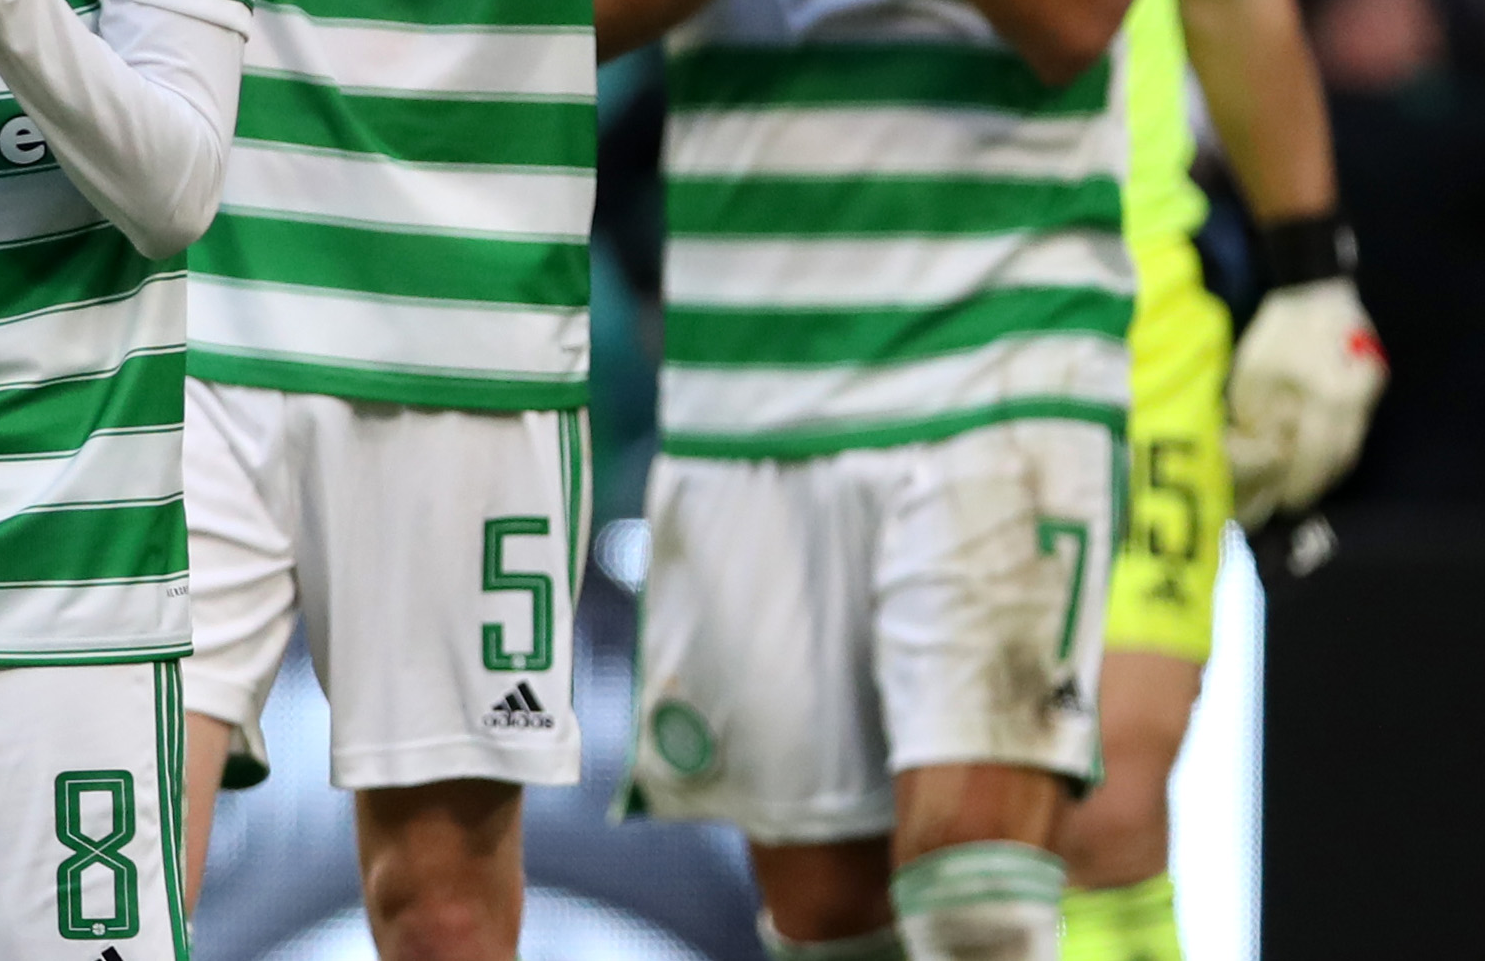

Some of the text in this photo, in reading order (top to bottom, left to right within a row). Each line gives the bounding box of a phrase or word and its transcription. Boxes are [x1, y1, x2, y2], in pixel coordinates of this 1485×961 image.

[482, 516, 554, 672] 5
[1036, 515, 1089, 660] 7
[483, 709, 555, 730] adidas
[55, 769, 140, 940] 8
